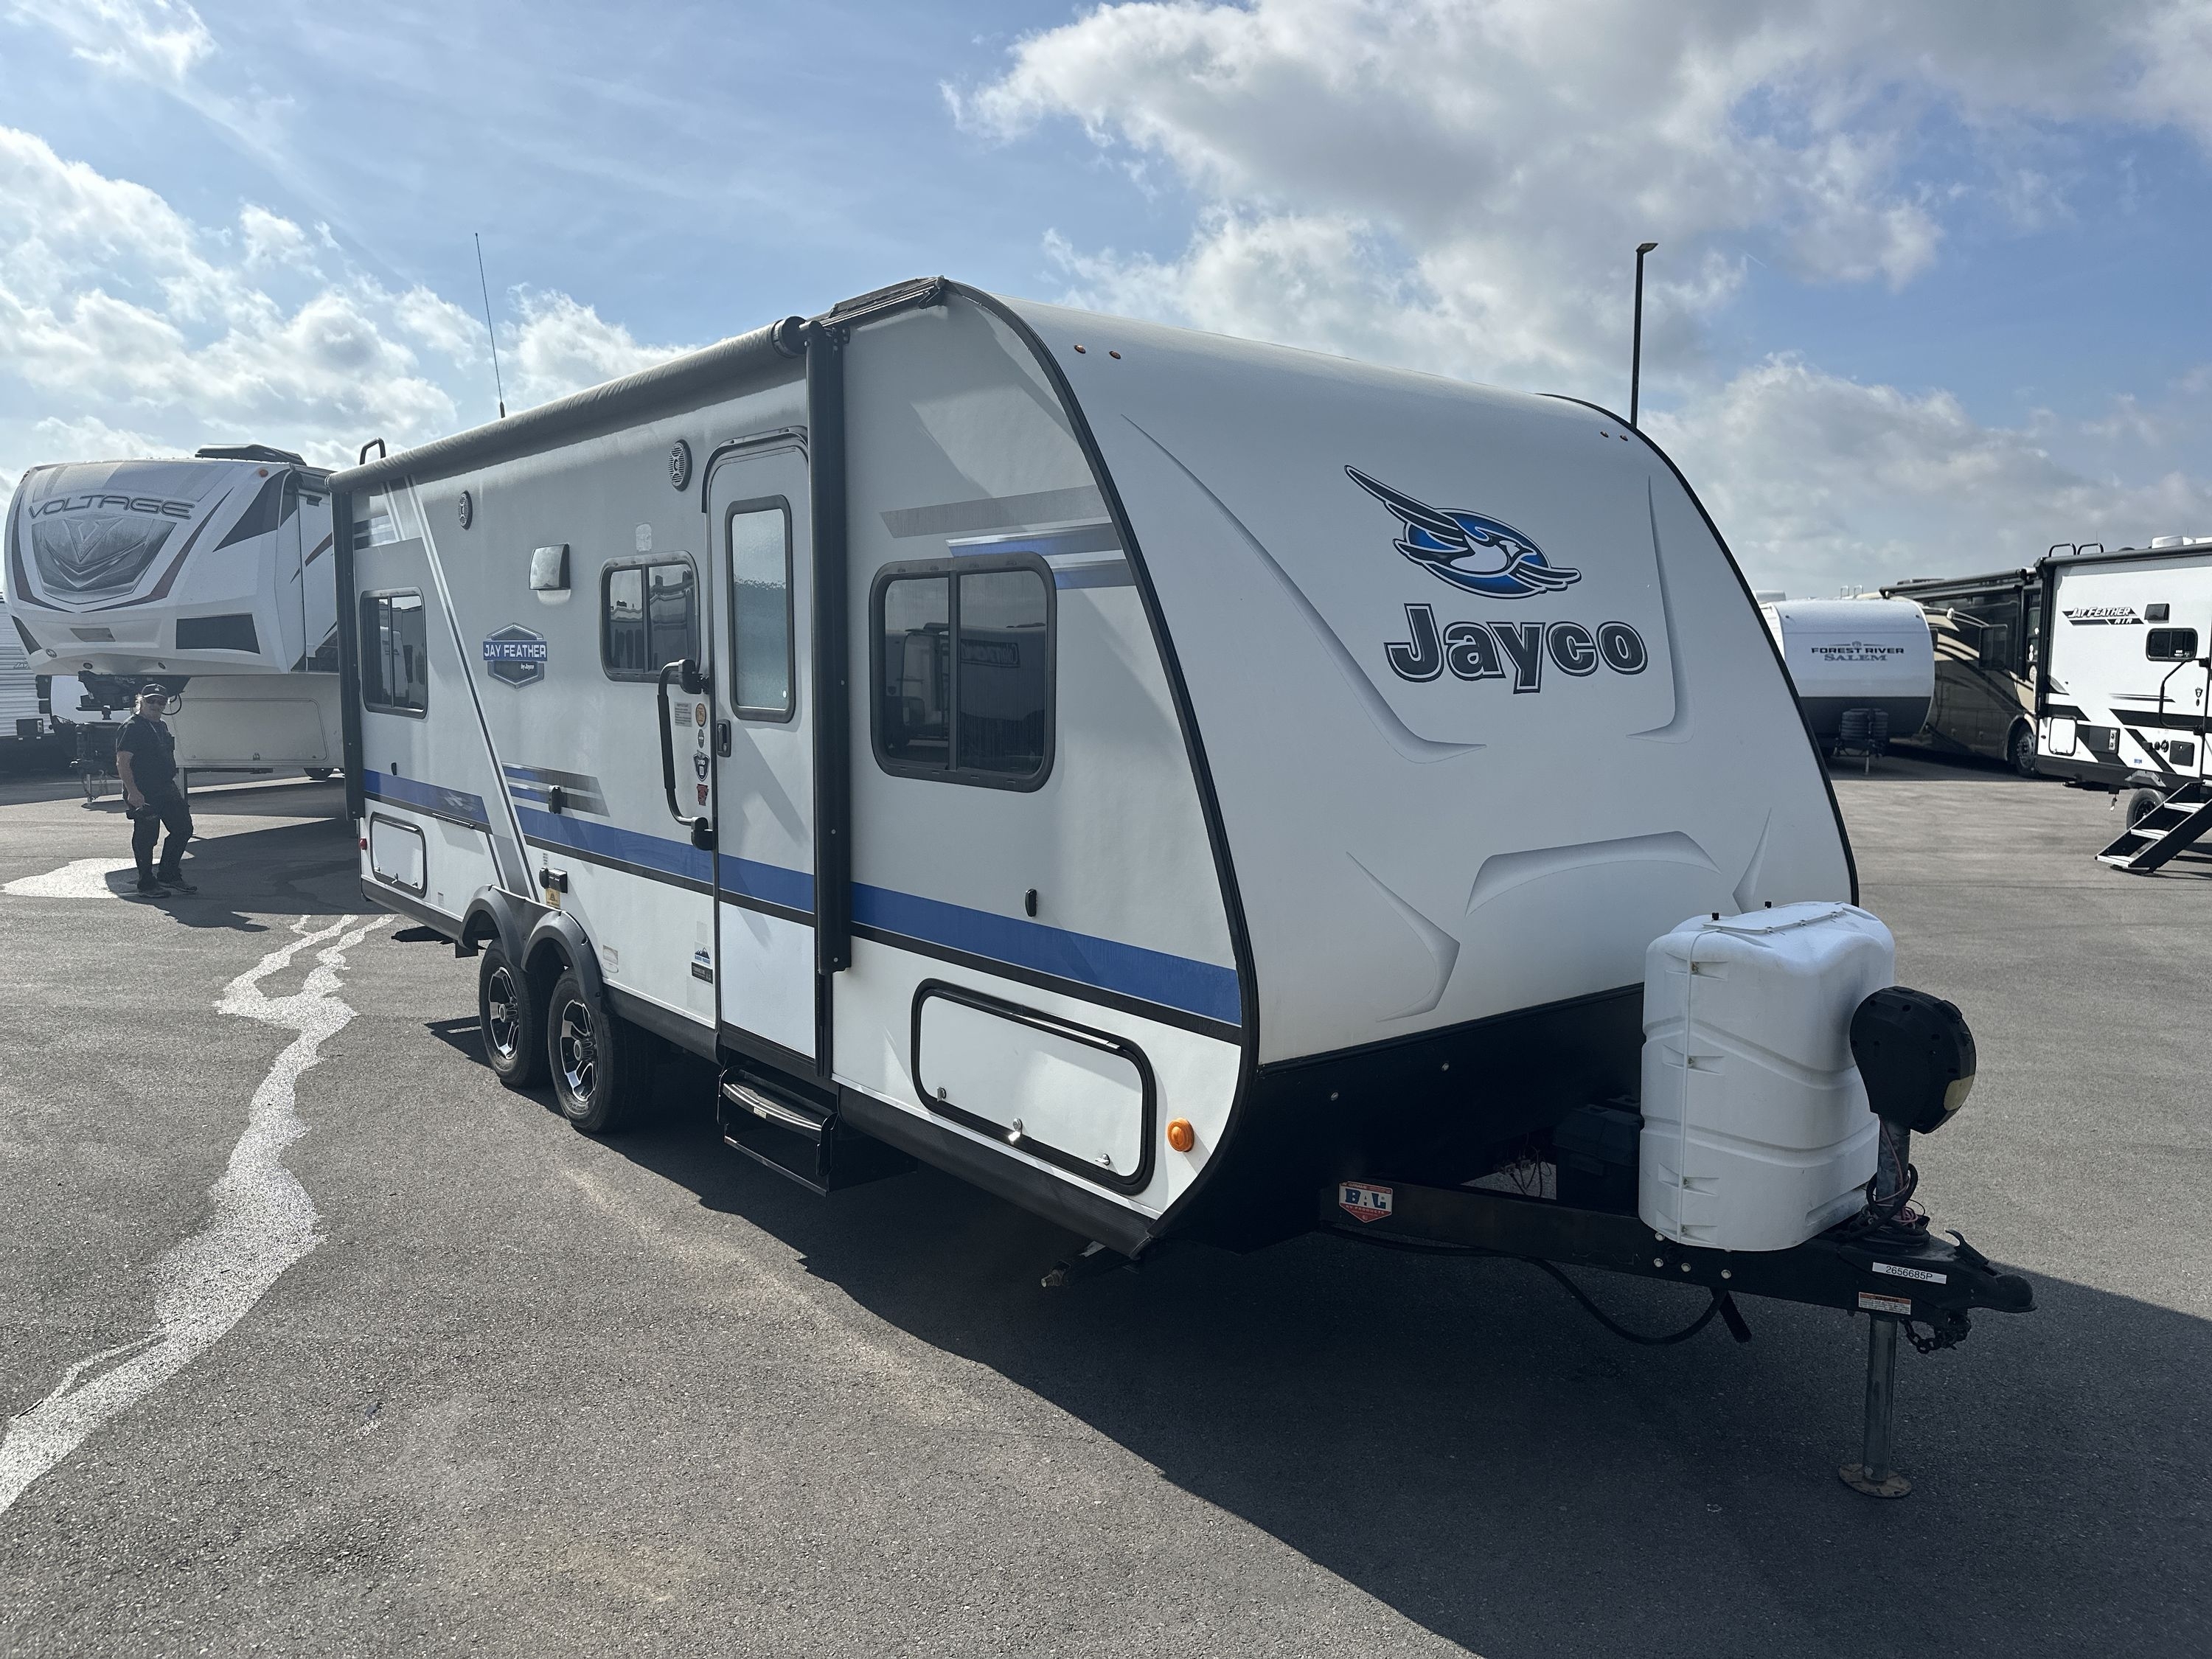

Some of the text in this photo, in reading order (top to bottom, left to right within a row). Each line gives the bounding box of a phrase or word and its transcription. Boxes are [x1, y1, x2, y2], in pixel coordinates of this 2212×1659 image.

[28, 494, 195, 520] VOLTAGE
[2067, 606, 2131, 619] JAY FEATHER
[484, 644, 546, 658] JAY FEATHER
[1383, 603, 1648, 695] Jayco
[1824, 653, 1888, 661] SALEM
[1345, 1188, 1386, 1209] BAL
[1885, 1265, 1933, 1280] 2656685P
